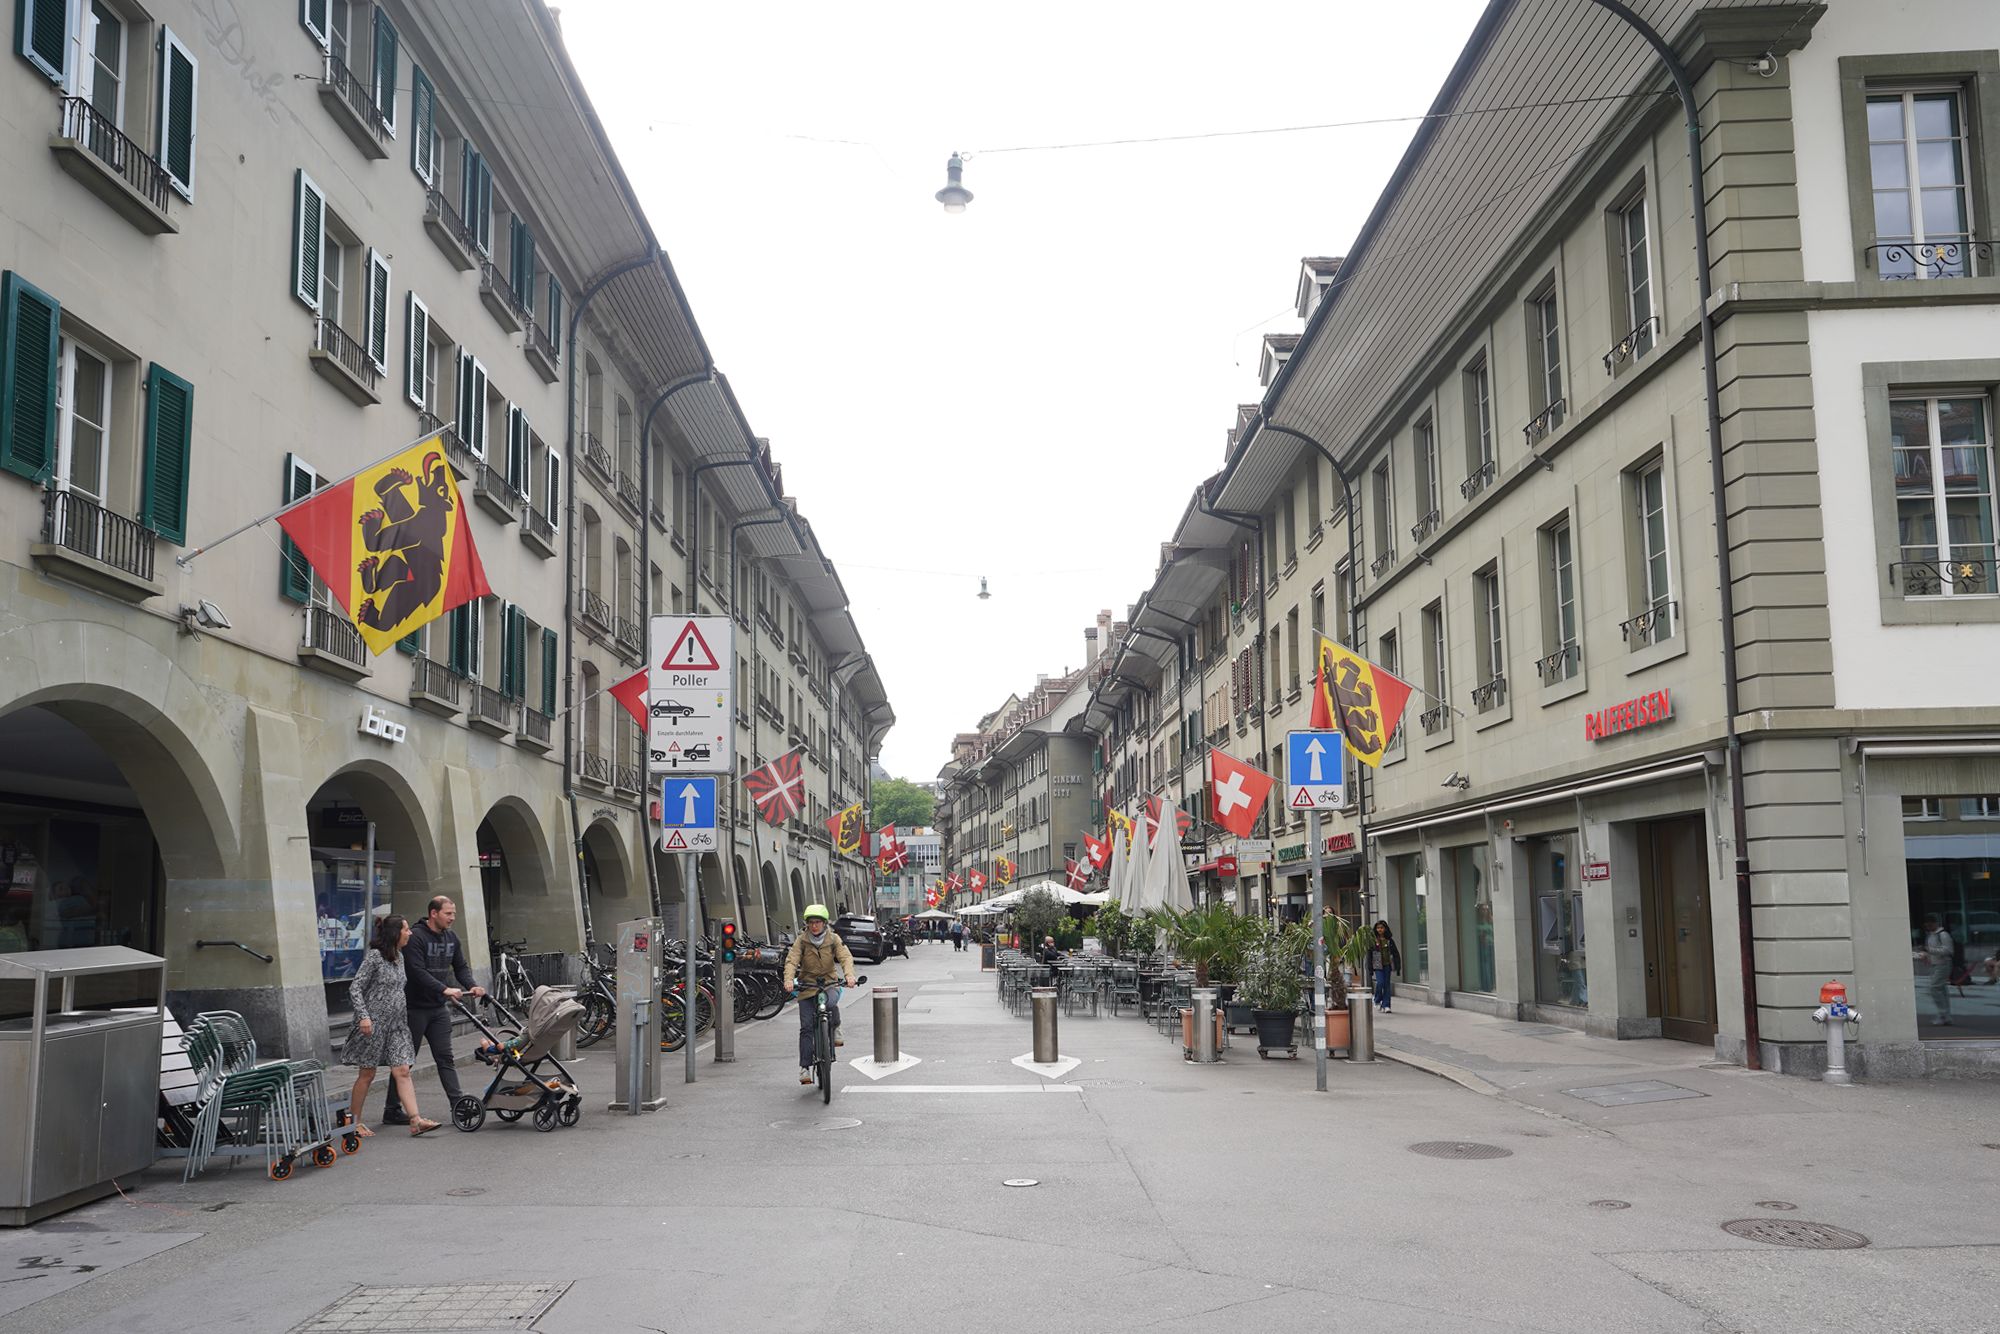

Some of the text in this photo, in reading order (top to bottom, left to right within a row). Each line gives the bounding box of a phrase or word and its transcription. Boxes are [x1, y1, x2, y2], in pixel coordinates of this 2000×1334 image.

[672, 674, 708, 686] Poller
[1585, 688, 1670, 742] RAIFFEISEN
[360, 705, 407, 744] bico
[1053, 775, 1081, 784] CINEMA
[1053, 788, 1071, 797] CITY
[1327, 832, 1356, 852] PIZZERIA
